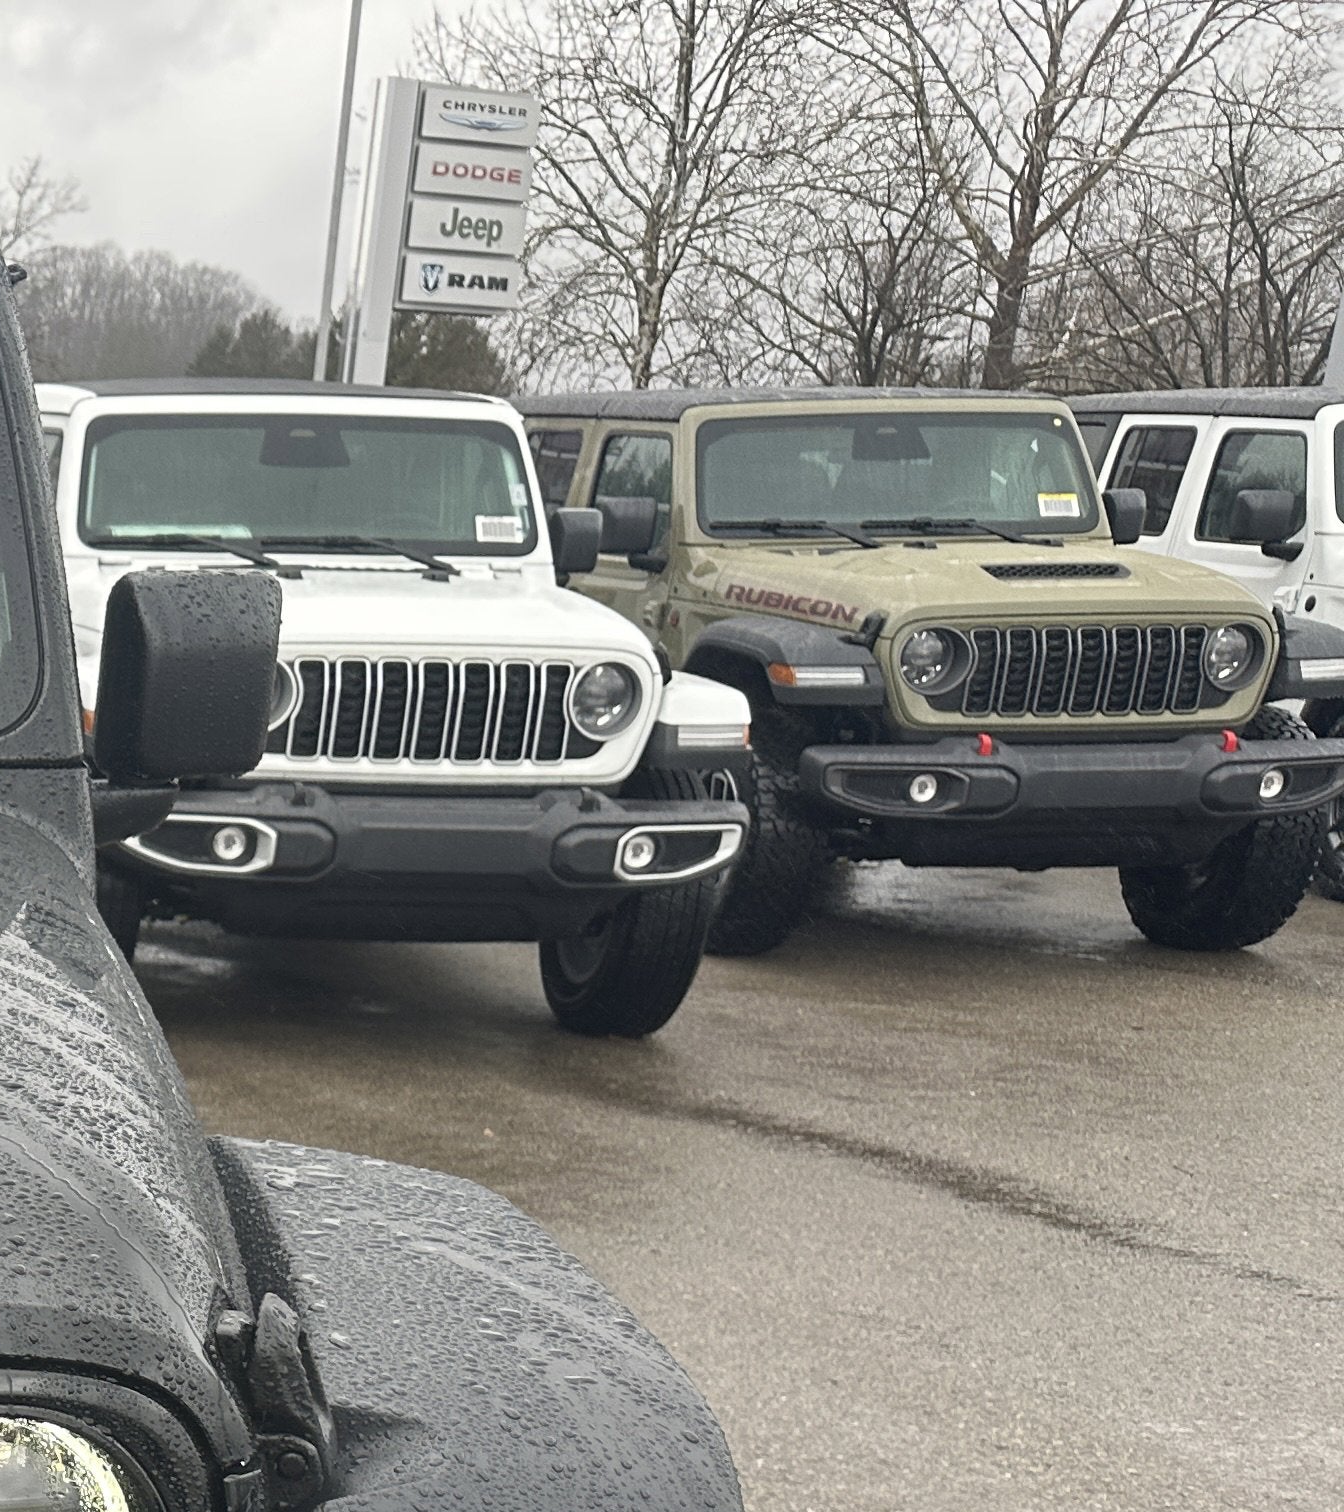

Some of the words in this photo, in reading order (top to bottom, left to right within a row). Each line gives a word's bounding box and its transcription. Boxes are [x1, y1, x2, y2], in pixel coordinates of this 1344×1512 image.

[442, 100, 528, 117] CHRYSLER
[432, 160, 522, 184] DODGE
[440, 207, 503, 248] Jeep
[447, 272, 509, 291] RAM
[725, 584, 859, 624] RUBICON
